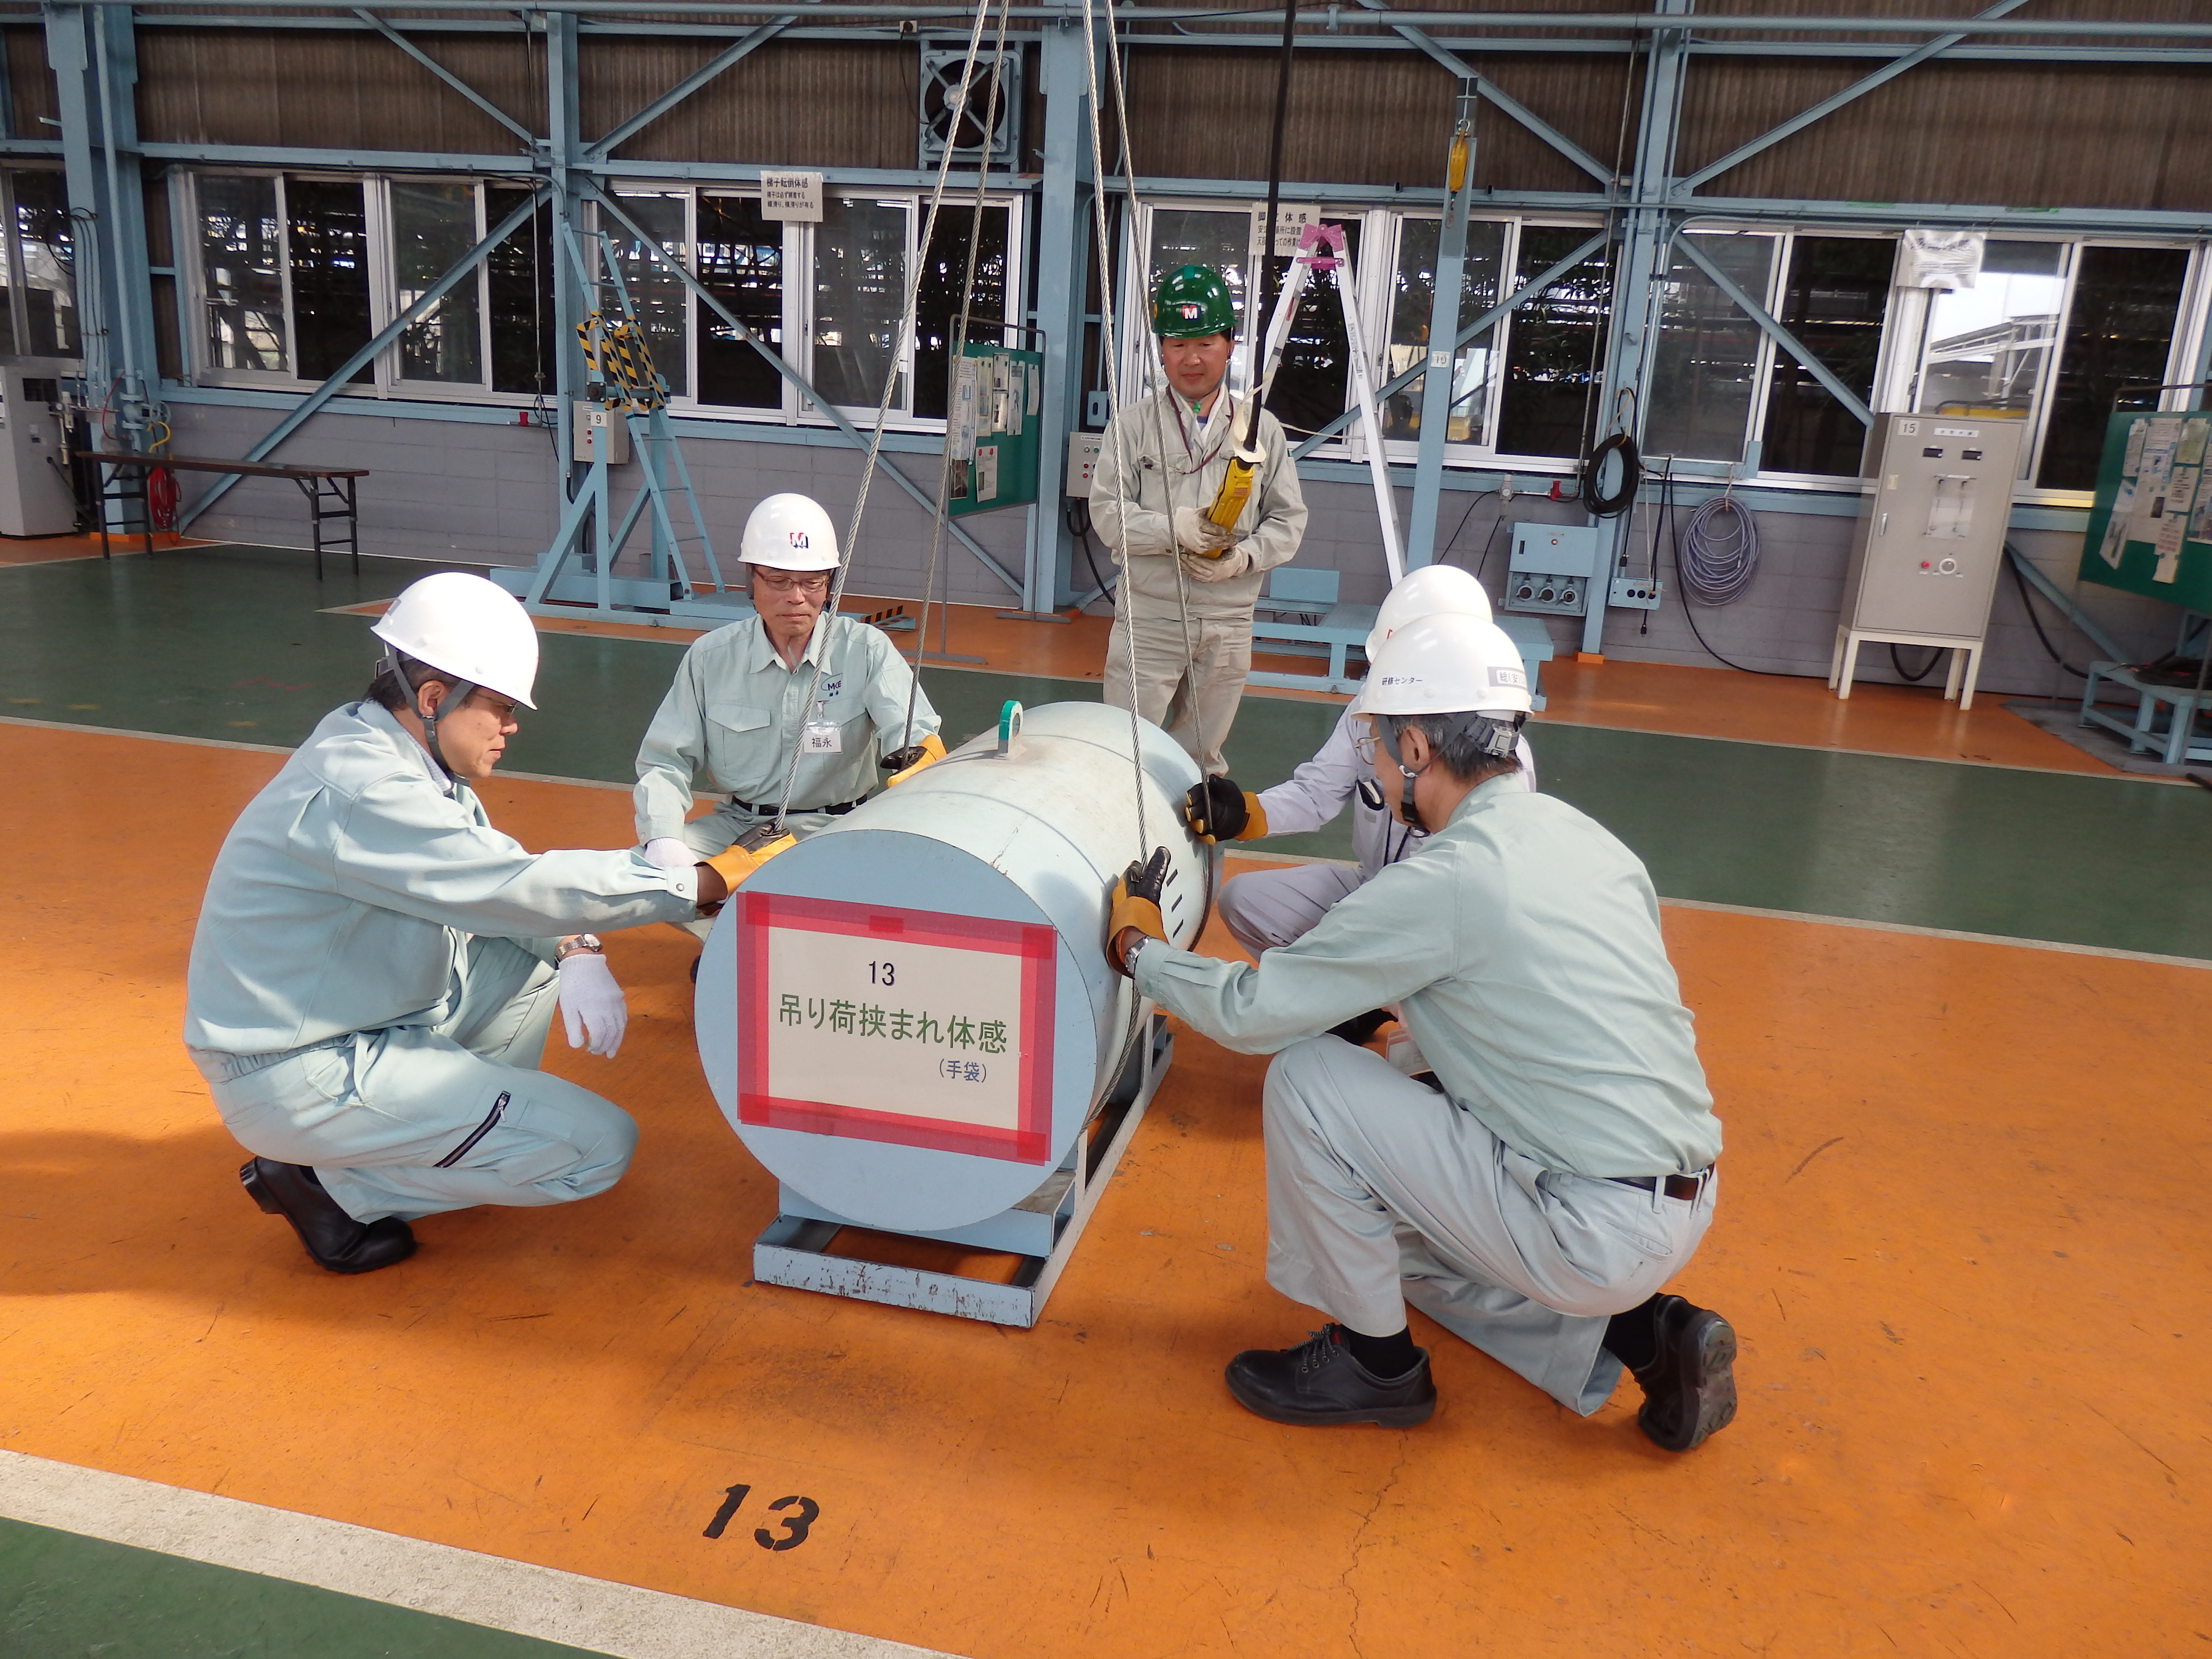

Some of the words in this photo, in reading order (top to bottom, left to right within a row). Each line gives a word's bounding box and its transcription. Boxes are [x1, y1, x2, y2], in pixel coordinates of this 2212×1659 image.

[1258, 212, 1306, 223] 脚体感
[1435, 355, 1447, 364] 10
[596, 415, 601, 424] 9
[1903, 423, 1916, 433] 15
[1382, 677, 1422, 685] 研修センター
[812, 737, 832, 748] 福永
[868, 961, 895, 986] 13
[780, 994, 1007, 1054] 吊り荷挟まれ体感
[939, 1058, 986, 1083] (手袋)
[703, 1483, 820, 1551] 13
